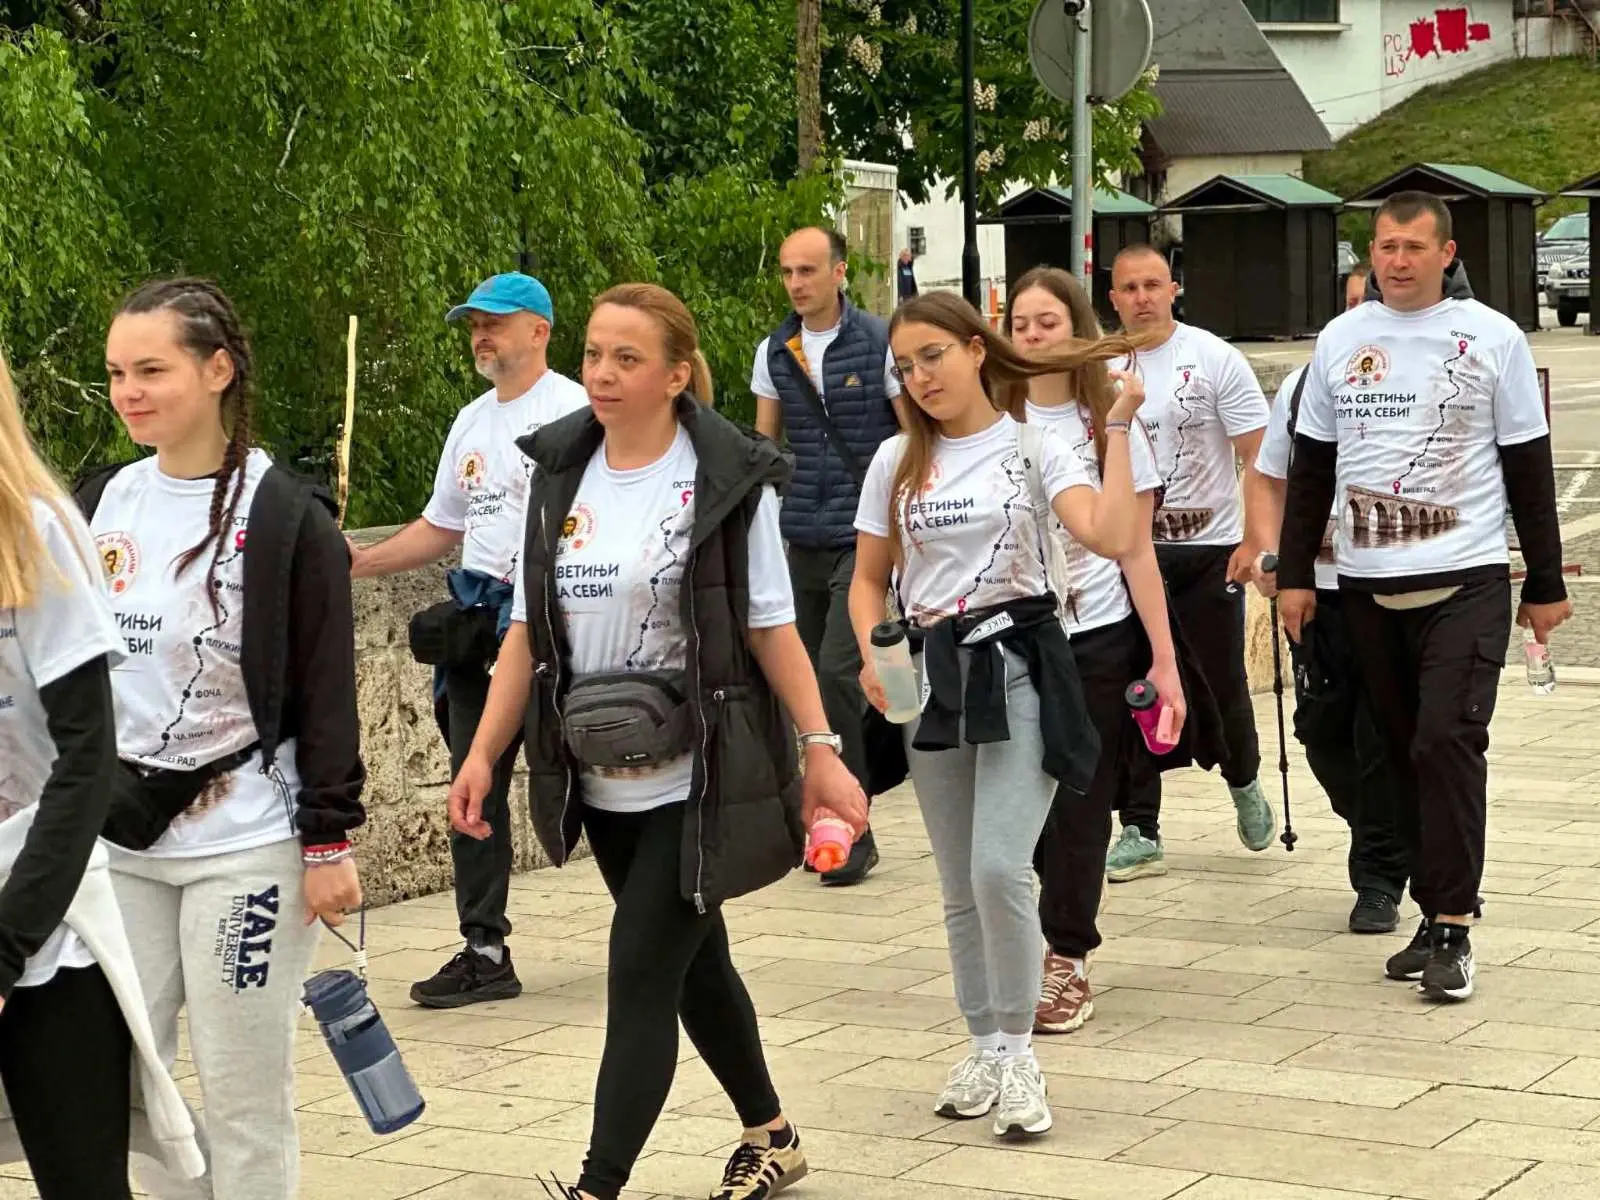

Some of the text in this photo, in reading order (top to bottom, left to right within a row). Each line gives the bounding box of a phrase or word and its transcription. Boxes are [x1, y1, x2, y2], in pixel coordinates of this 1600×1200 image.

[1341, 394, 1353, 404] КА
[1355, 393, 1416, 404] СВЕТИЊИ
[1355, 408, 1372, 418] КА
[1374, 407, 1410, 418] СЕБИ!
[925, 511, 969, 529] СЕБИ!
[556, 562, 620, 579] ВЕТИЊИ
[572, 582, 613, 598] СЕБИ!
[986, 614, 1011, 632] NIKE
[195, 688, 222, 698] ФОЧА
[221, 895, 245, 989] UNIVERSITY
[235, 884, 279, 990] YALE
